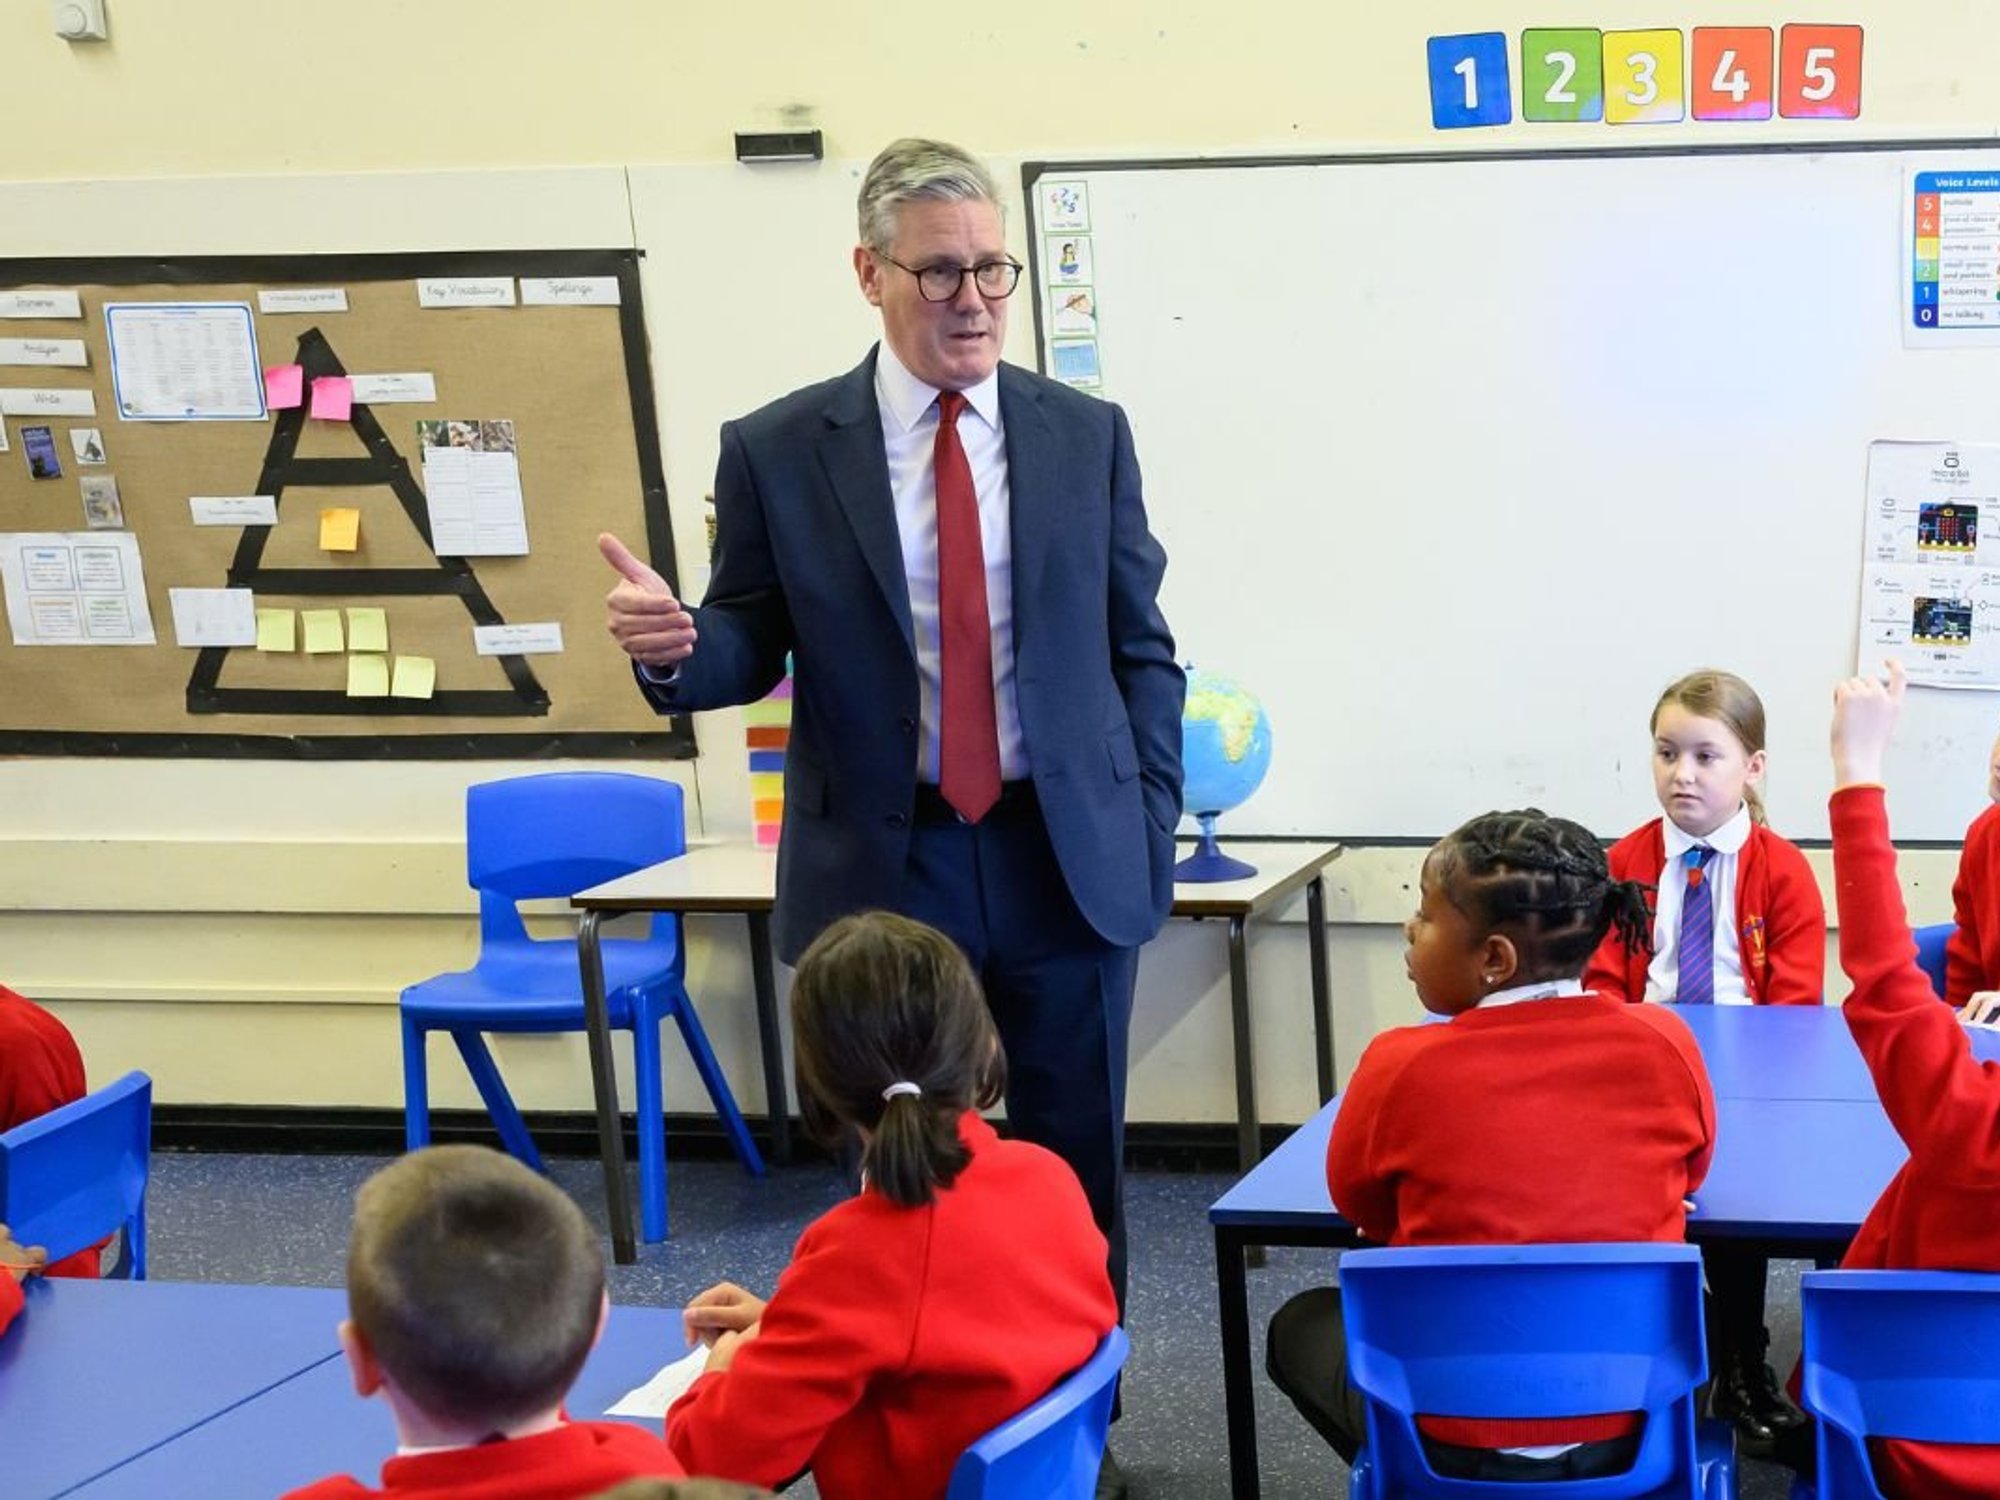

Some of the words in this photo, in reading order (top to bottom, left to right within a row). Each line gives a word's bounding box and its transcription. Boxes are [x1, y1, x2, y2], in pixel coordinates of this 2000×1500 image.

[1454, 56, 1478, 109] 1
[1544, 51, 1576, 103] 2
[1625, 51, 1658, 105] 3
[1711, 50, 1750, 102] 4
[1801, 48, 1836, 100] 5
[1934, 176, 1964, 188] Voice
[1966, 175, 2000, 188] Levels
[1922, 197, 1933, 212] 5
[1922, 217, 1933, 232] 4
[1923, 286, 1930, 300] 1
[1921, 308, 1932, 322] 0
